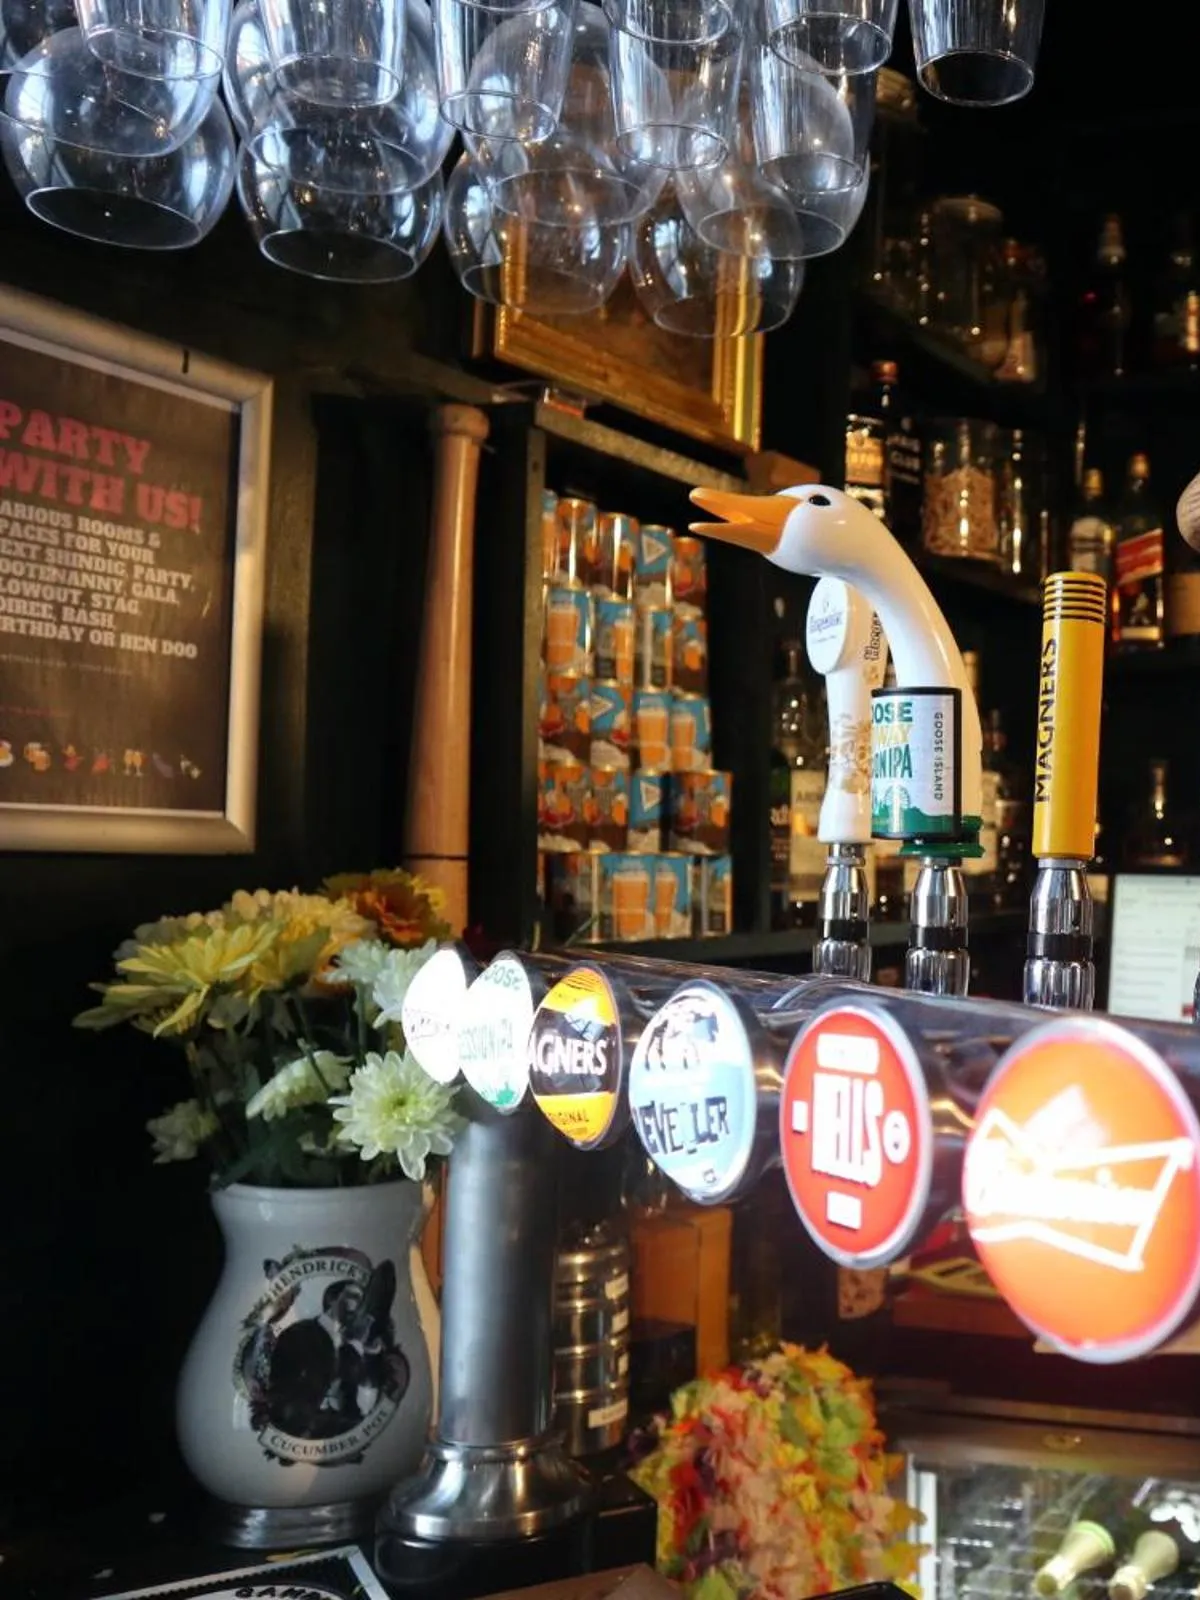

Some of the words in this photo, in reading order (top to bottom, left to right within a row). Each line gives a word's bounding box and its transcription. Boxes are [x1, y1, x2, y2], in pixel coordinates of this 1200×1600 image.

[0, 401, 152, 476] PARTY
[0, 448, 125, 515] WITH
[136, 482, 202, 534] US!
[63, 531, 102, 554] FOR
[105, 541, 155, 565] YOUR
[77, 515, 145, 545] ROOMS
[148, 531, 161, 549] &
[89, 628, 116, 648] OR
[119, 632, 158, 655] HEN
[160, 638, 198, 660] DOO
[871, 701, 913, 724] OSE
[933, 711, 944, 754] GOOSE
[1035, 638, 1057, 803] MAGNERS
[933, 755, 945, 802] ISLAND
[271, 1259, 372, 1299] HENDRICK'S
[269, 1433, 361, 1458] CUCUMBER
